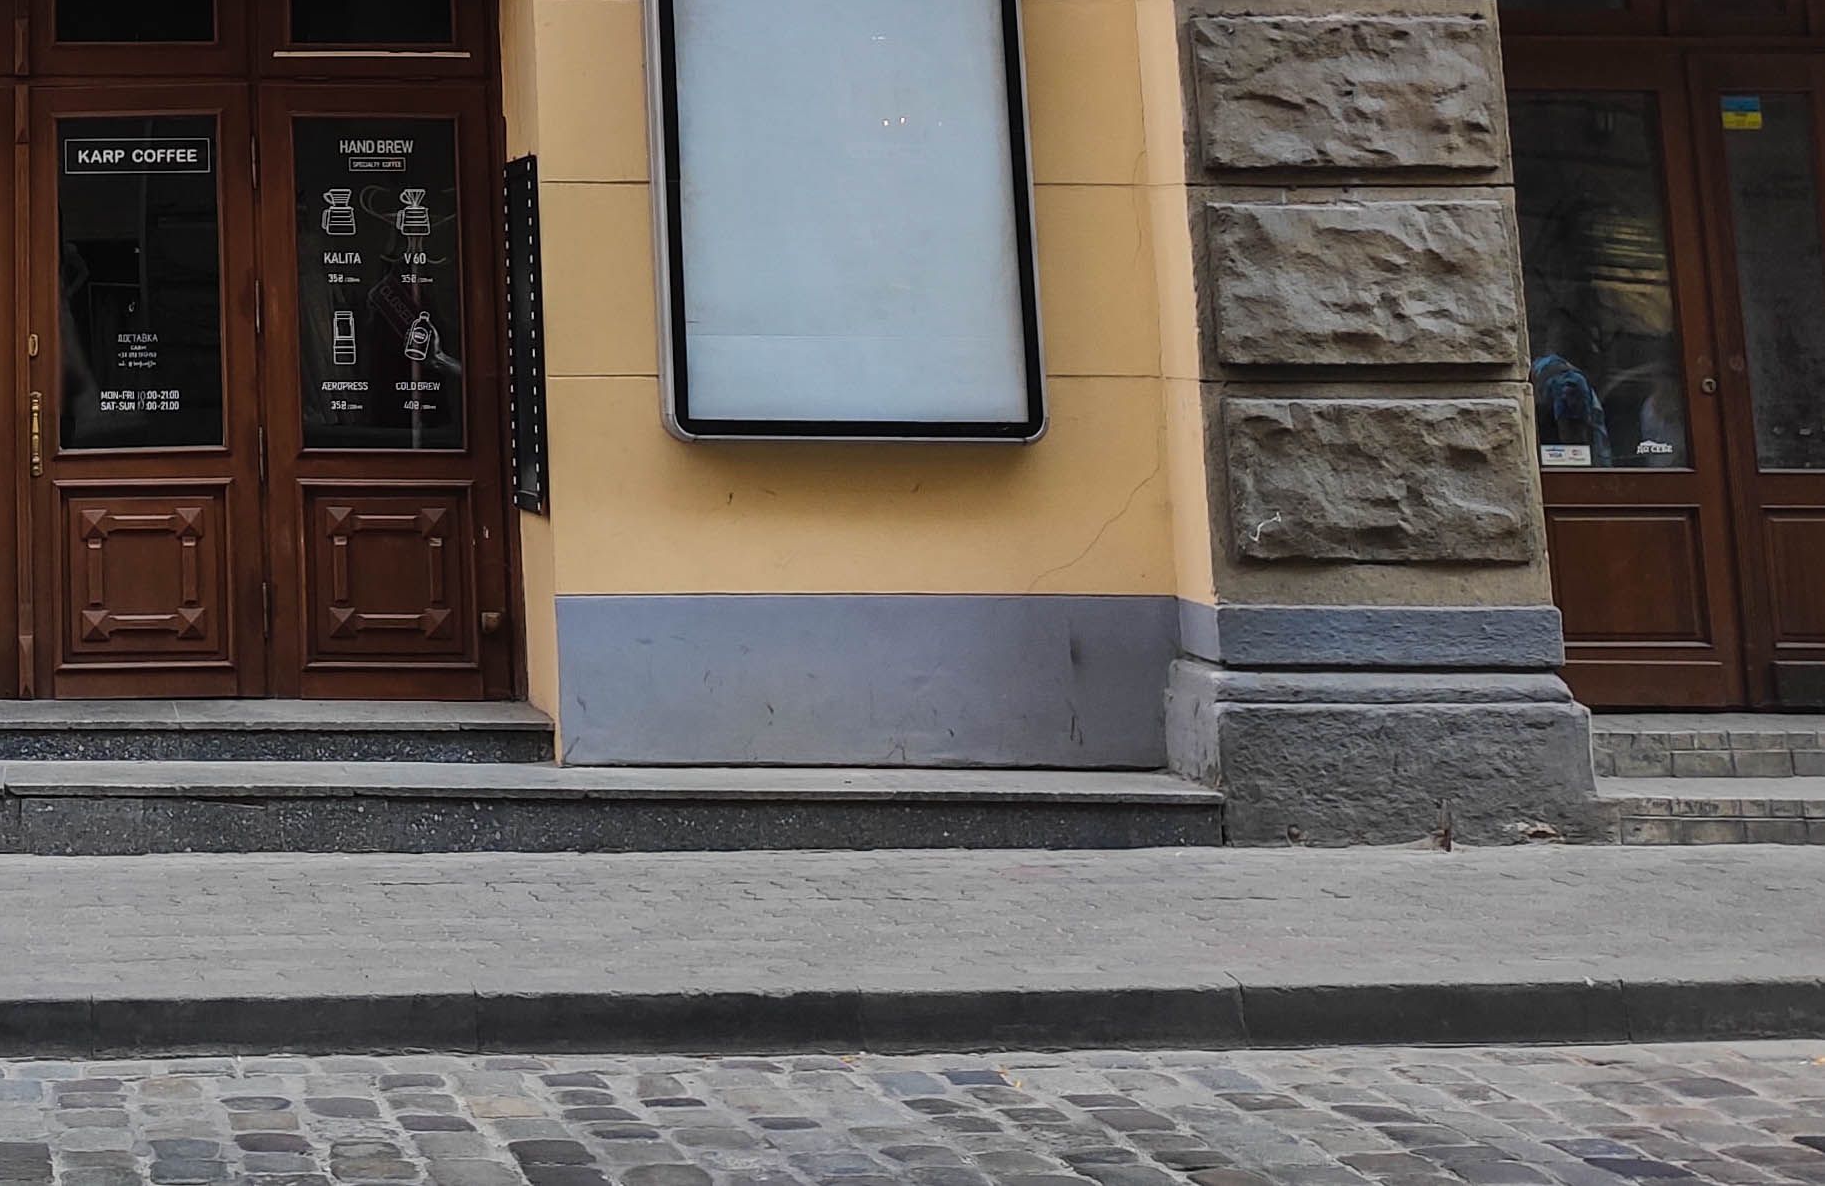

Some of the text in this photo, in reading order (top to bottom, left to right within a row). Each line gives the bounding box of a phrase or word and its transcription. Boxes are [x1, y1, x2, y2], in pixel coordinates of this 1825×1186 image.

[339, 140, 413, 154] HAND BREW
[78, 149, 198, 164] KARP COFFEE
[324, 252, 361, 264] KALITA
[117, 333, 158, 343] ДОСТАВКА
[321, 381, 368, 391] AEROPRESS
[395, 381, 441, 391] COLD BREW
